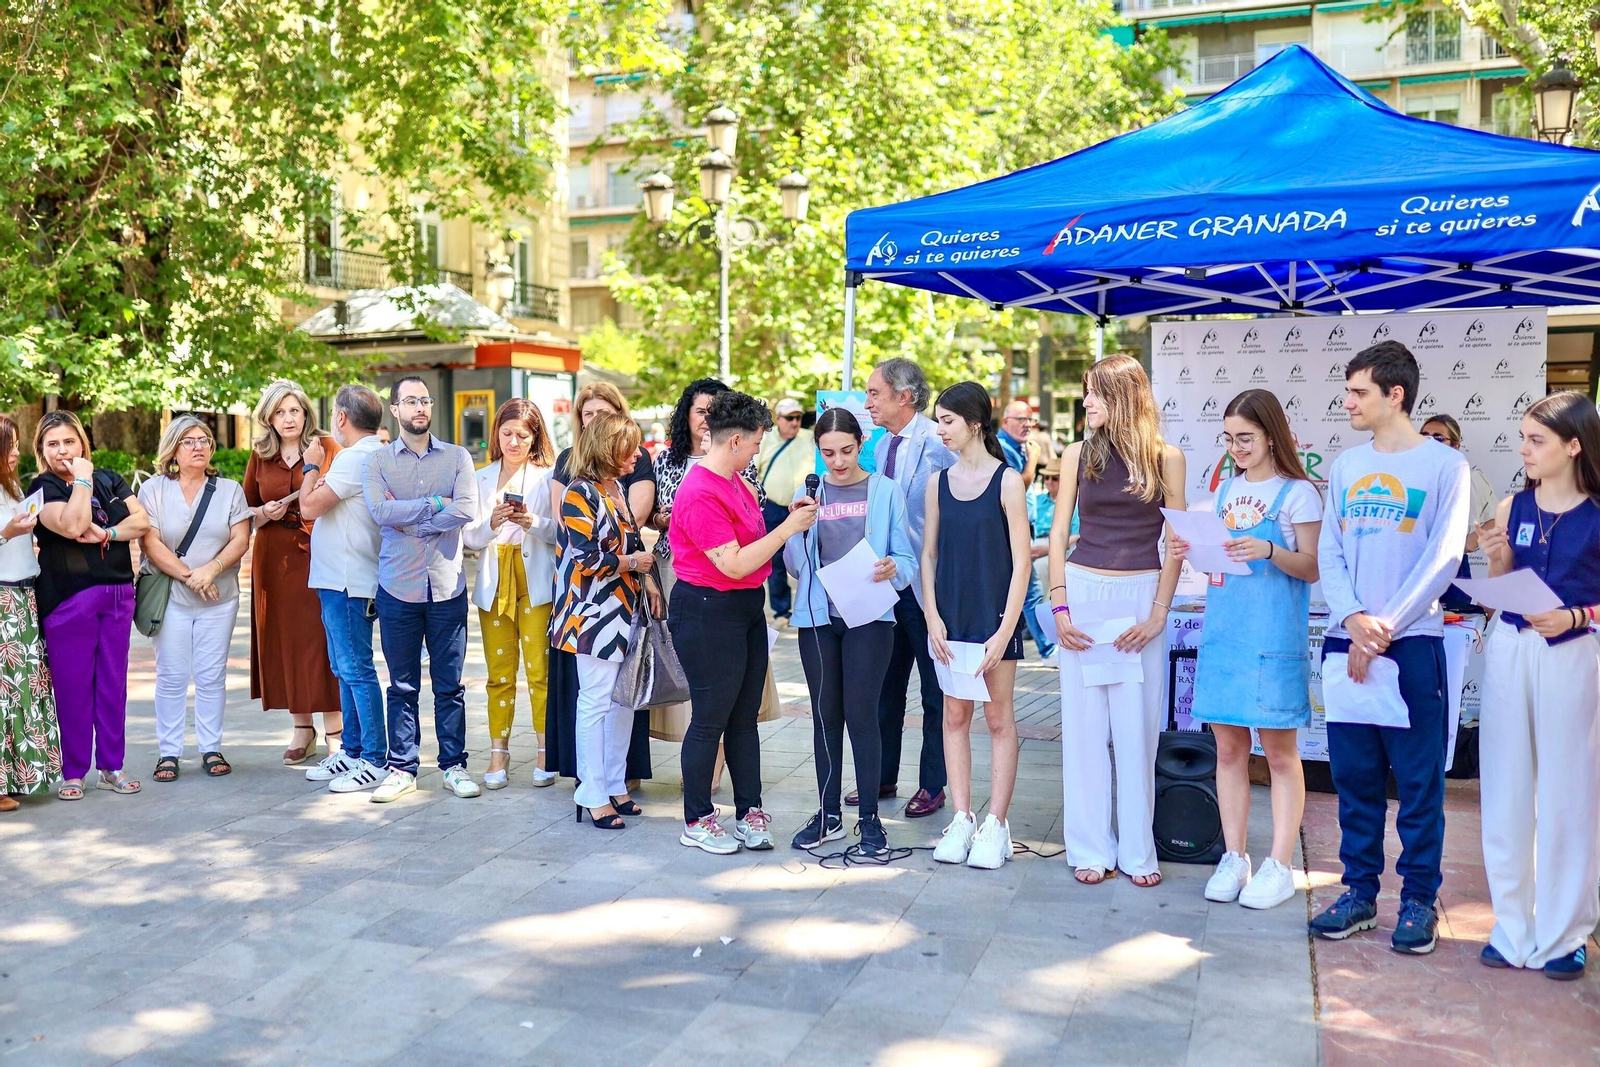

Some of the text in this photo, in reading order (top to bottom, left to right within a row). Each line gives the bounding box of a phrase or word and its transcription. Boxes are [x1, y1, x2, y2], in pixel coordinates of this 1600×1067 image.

[1401, 193, 1510, 214] Quieres
[1050, 208, 1347, 249] ADANER GRANADA
[1375, 212, 1537, 236] si te quieres
[920, 229, 1000, 246] Quieres
[903, 245, 1020, 265] si te quieres
[465, 396, 488, 407] ATM
[1174, 618, 1199, 629] 2 de
